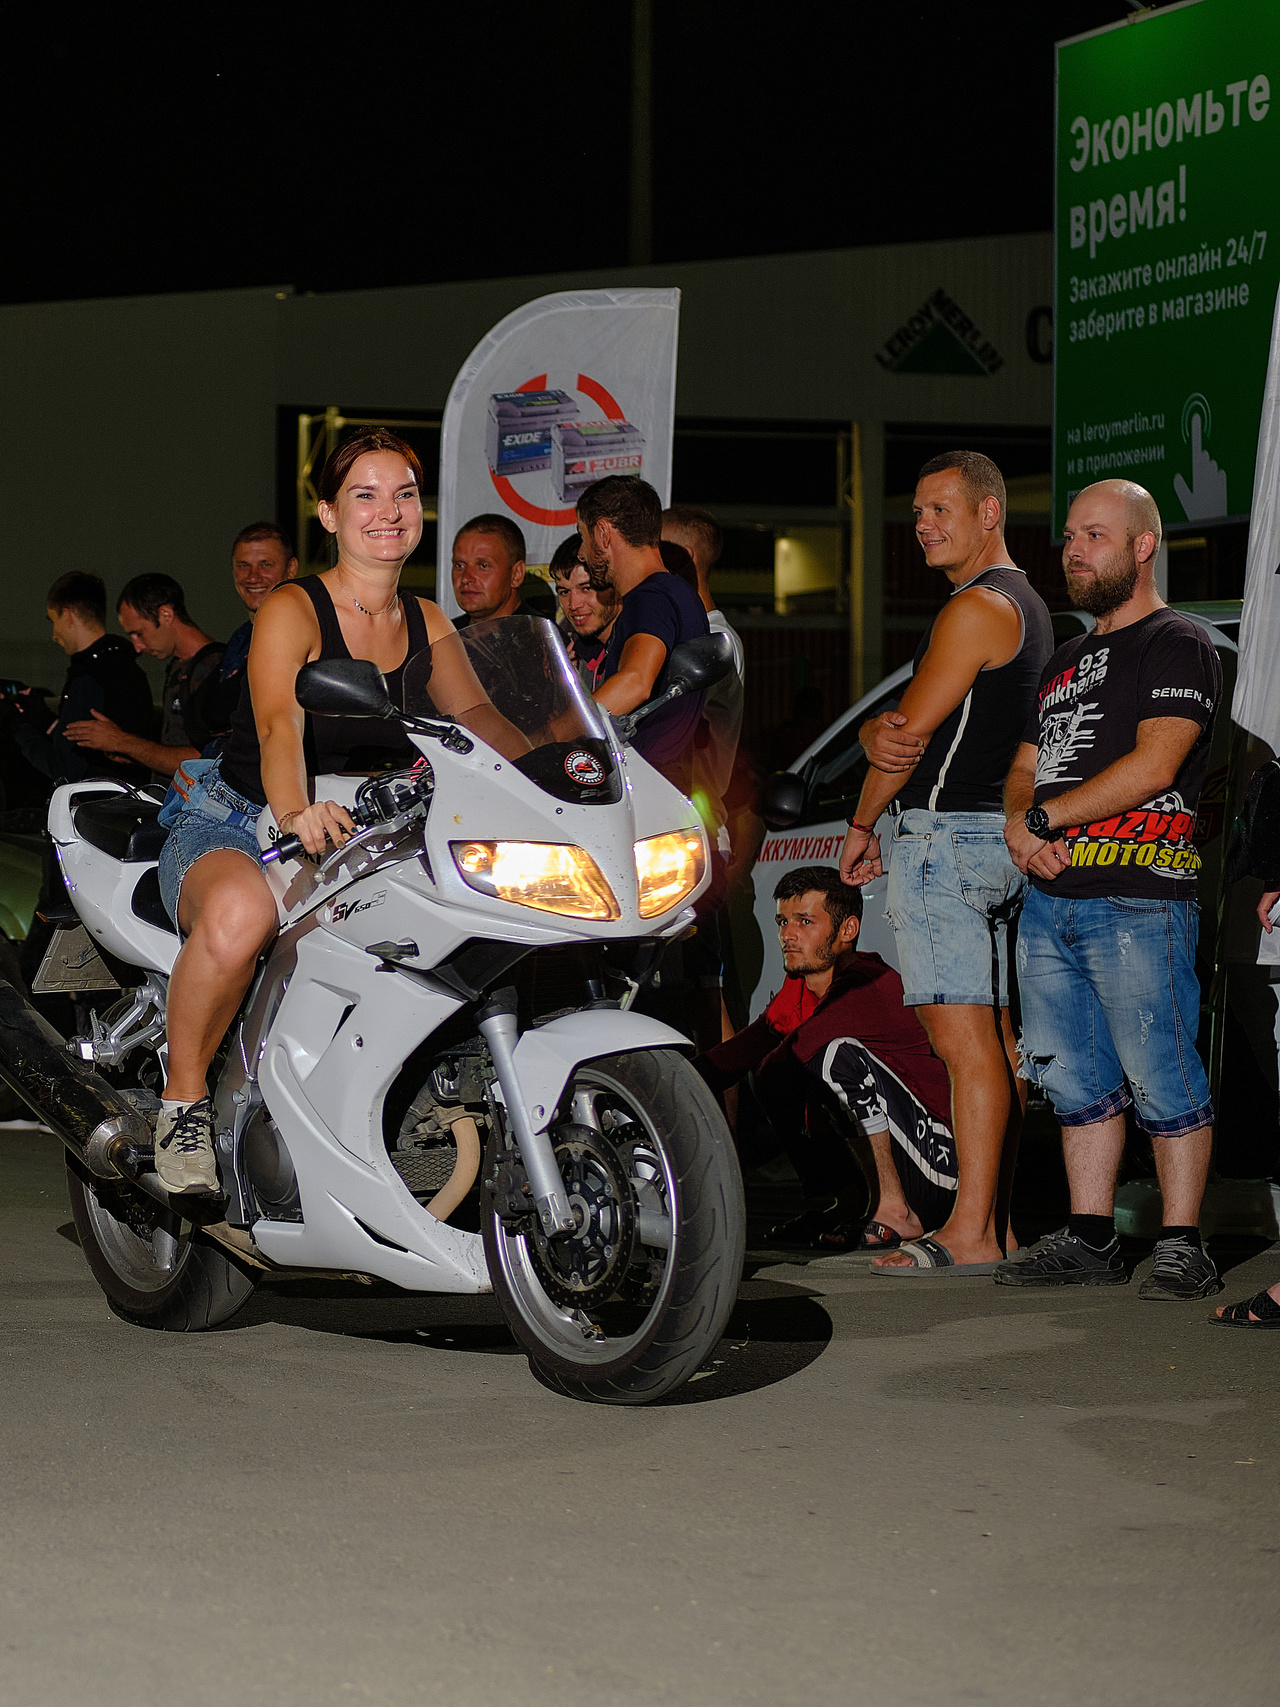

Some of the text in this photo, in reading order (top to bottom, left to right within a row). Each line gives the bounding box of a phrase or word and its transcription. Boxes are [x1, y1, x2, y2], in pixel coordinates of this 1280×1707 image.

[1070, 74, 1271, 173] Экономьте
[1070, 164, 1187, 260] время!
[1070, 229, 1268, 304] Закажите онлайн 24/7
[876, 288, 1003, 374] LEROY MERLIN
[1070, 282, 1251, 342] заберите в магазине
[503, 431, 542, 446] EXIDE
[1067, 411, 1165, 445] на leroymerlin.ru
[593, 456, 640, 471] ZUBR
[1067, 443, 1165, 477] и в приложении
[1078, 647, 1110, 677] 93
